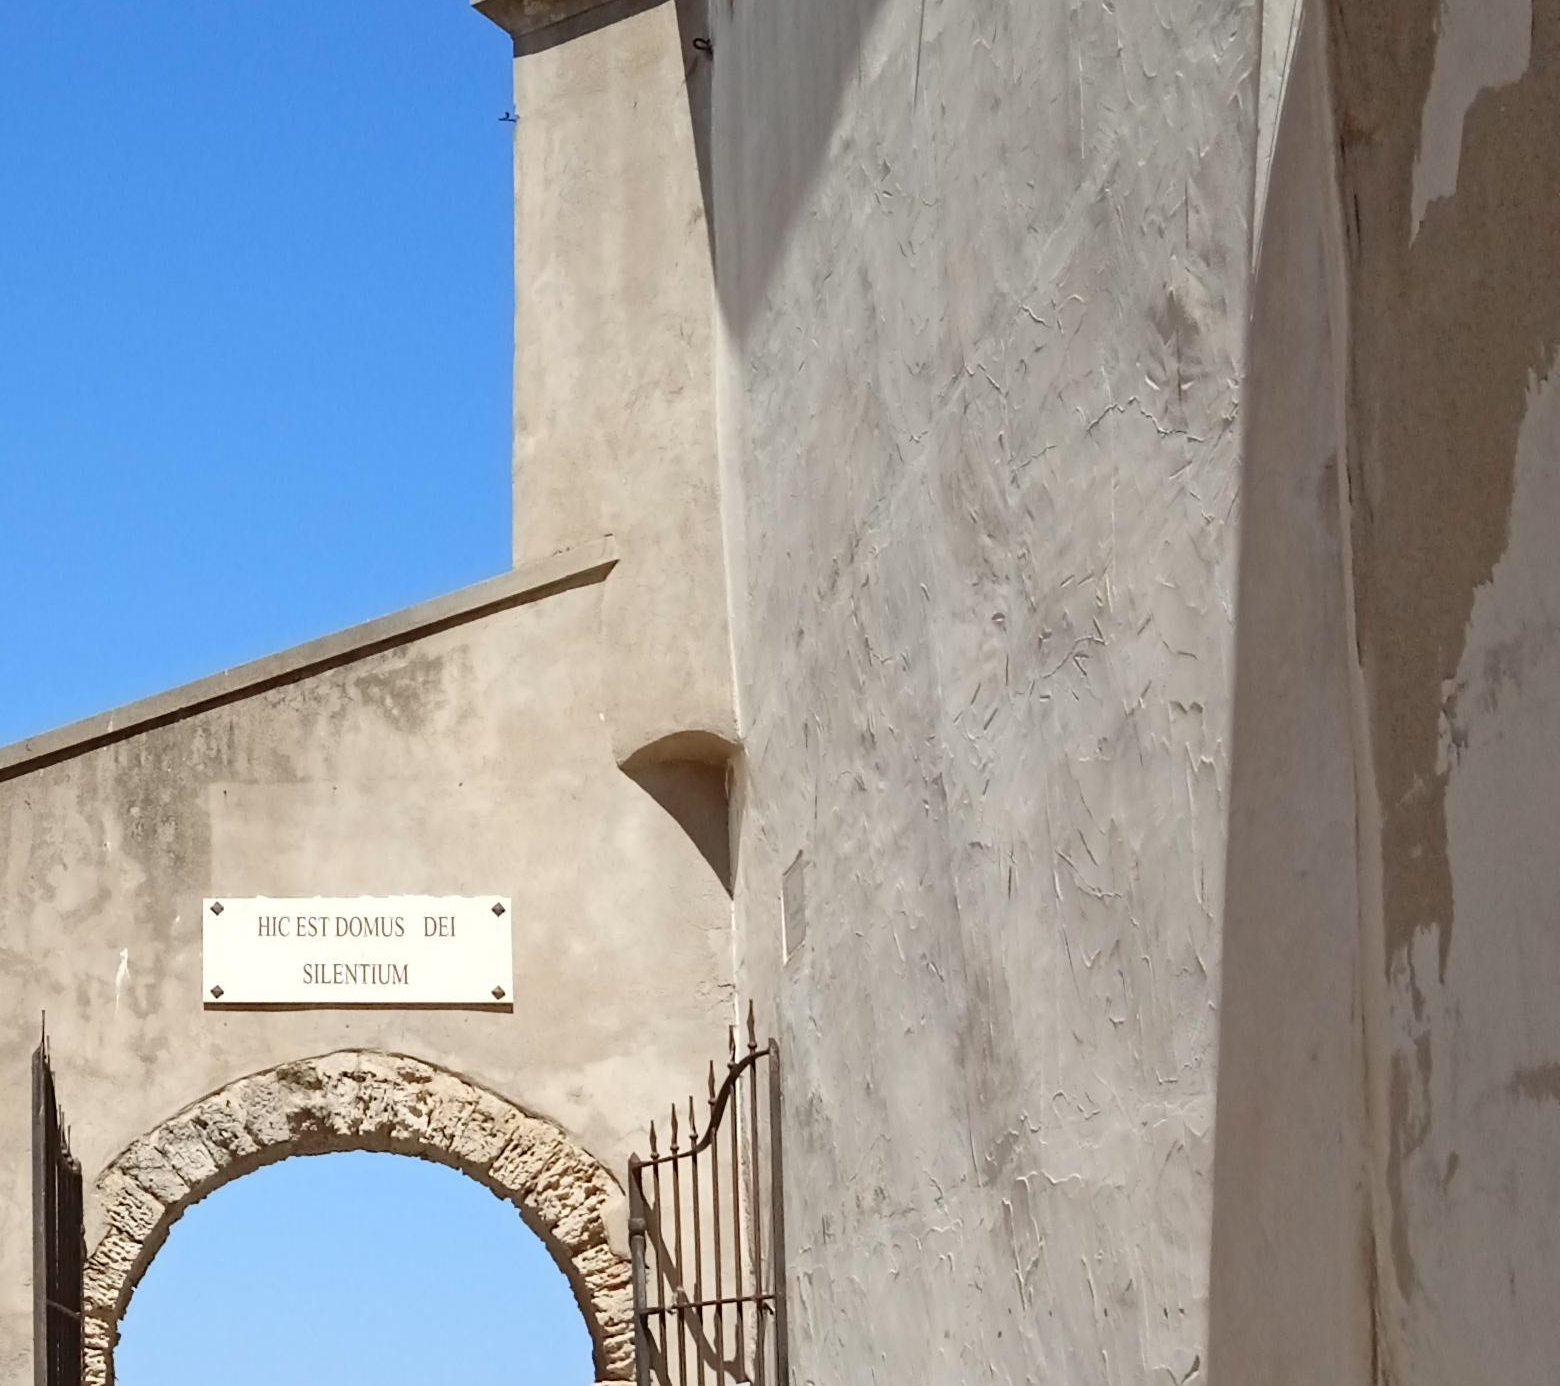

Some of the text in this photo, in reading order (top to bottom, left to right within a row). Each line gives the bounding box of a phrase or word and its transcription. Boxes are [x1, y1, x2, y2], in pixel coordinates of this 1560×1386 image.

[257, 915, 457, 938] HIC EST DOMUS DEI
[302, 963, 409, 985] SILENTIUM
